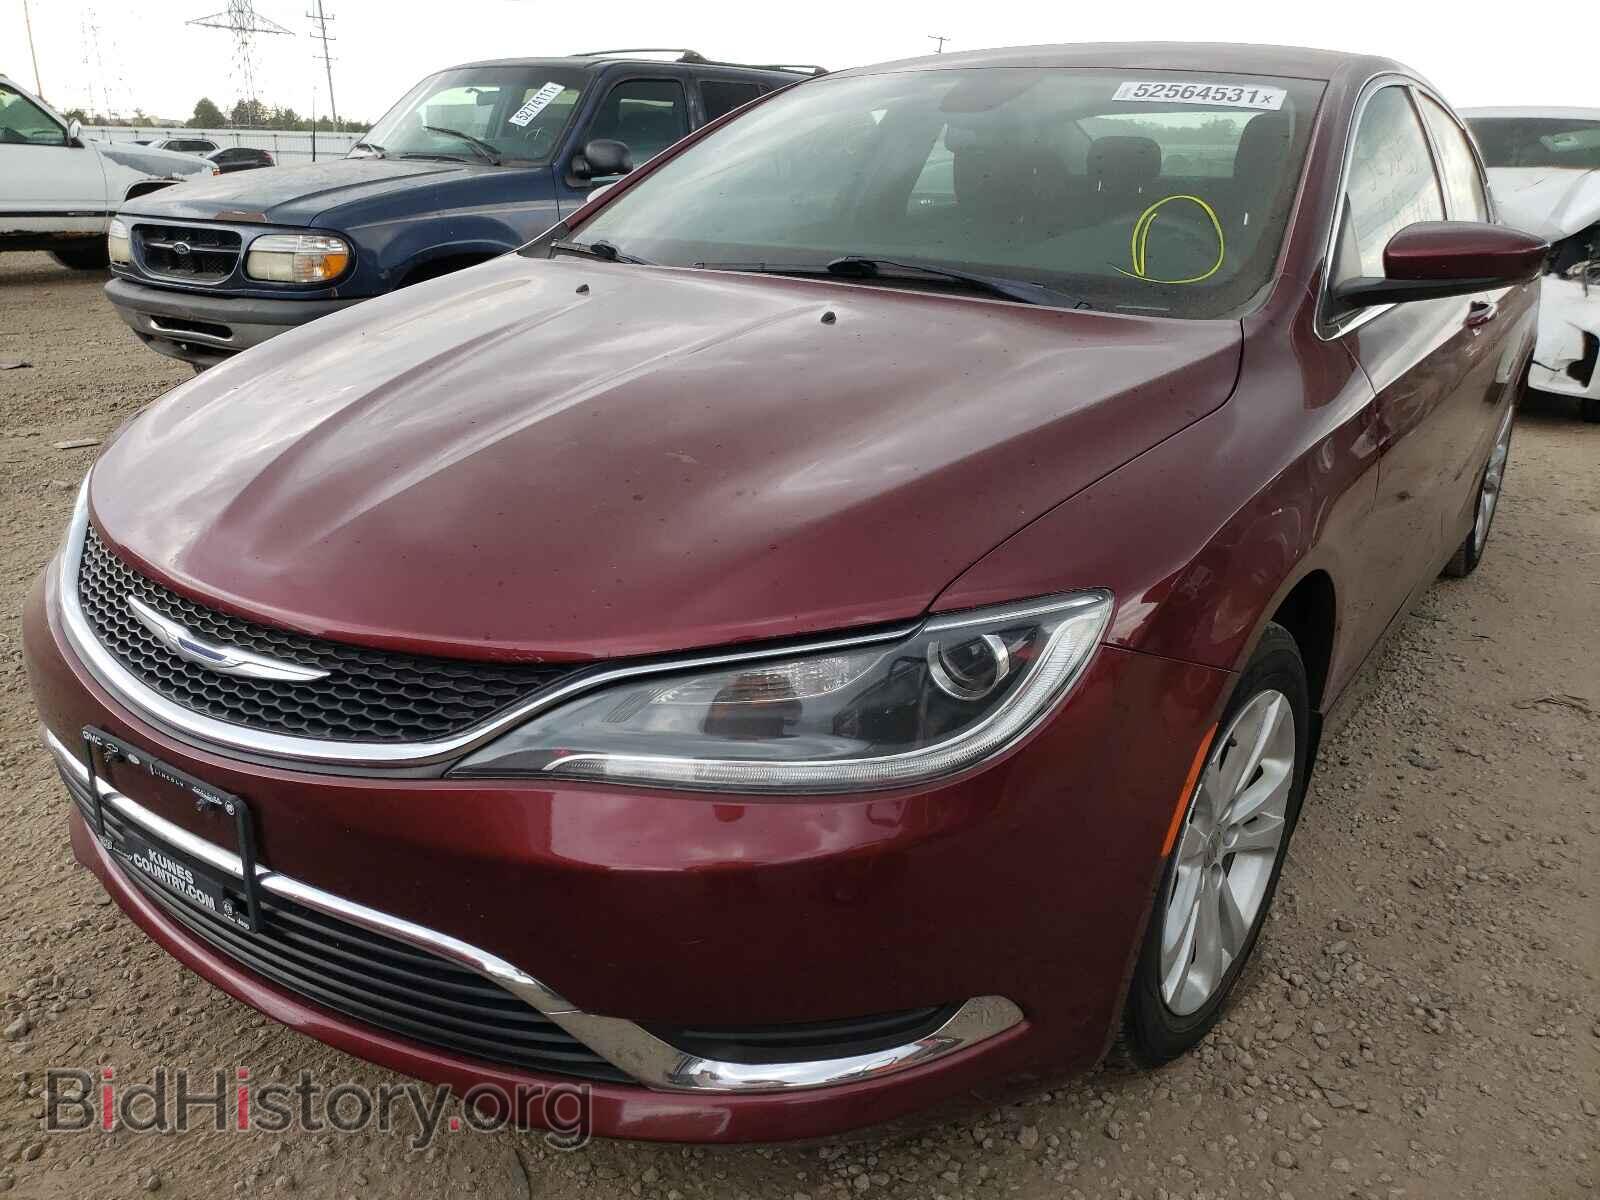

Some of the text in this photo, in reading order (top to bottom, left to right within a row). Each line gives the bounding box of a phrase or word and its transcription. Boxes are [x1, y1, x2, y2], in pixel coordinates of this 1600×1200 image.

[1132, 84, 1259, 103] 52564531
[133, 852, 216, 911] COUNTRY.COM
[148, 848, 194, 885] KUNES
